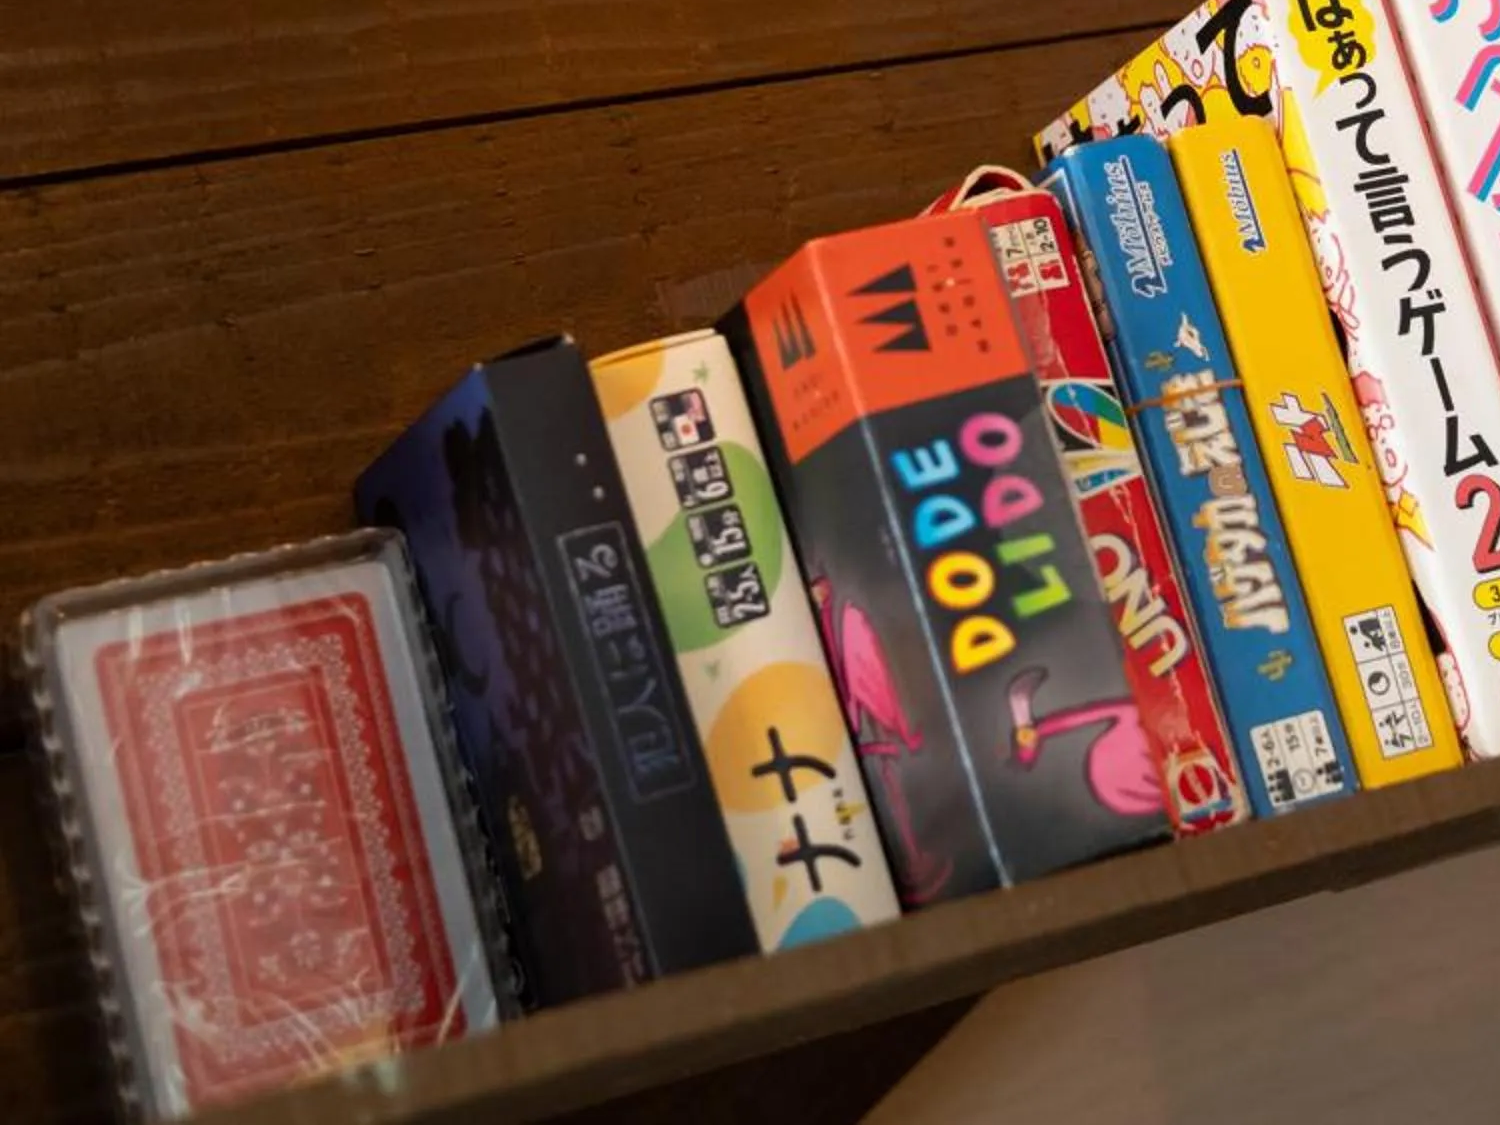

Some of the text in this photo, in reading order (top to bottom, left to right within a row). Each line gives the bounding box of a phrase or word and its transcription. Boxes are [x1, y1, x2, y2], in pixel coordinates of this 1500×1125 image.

[576, 543, 684, 773] 犯人は踊る
[1090, 533, 1189, 678] UNO
